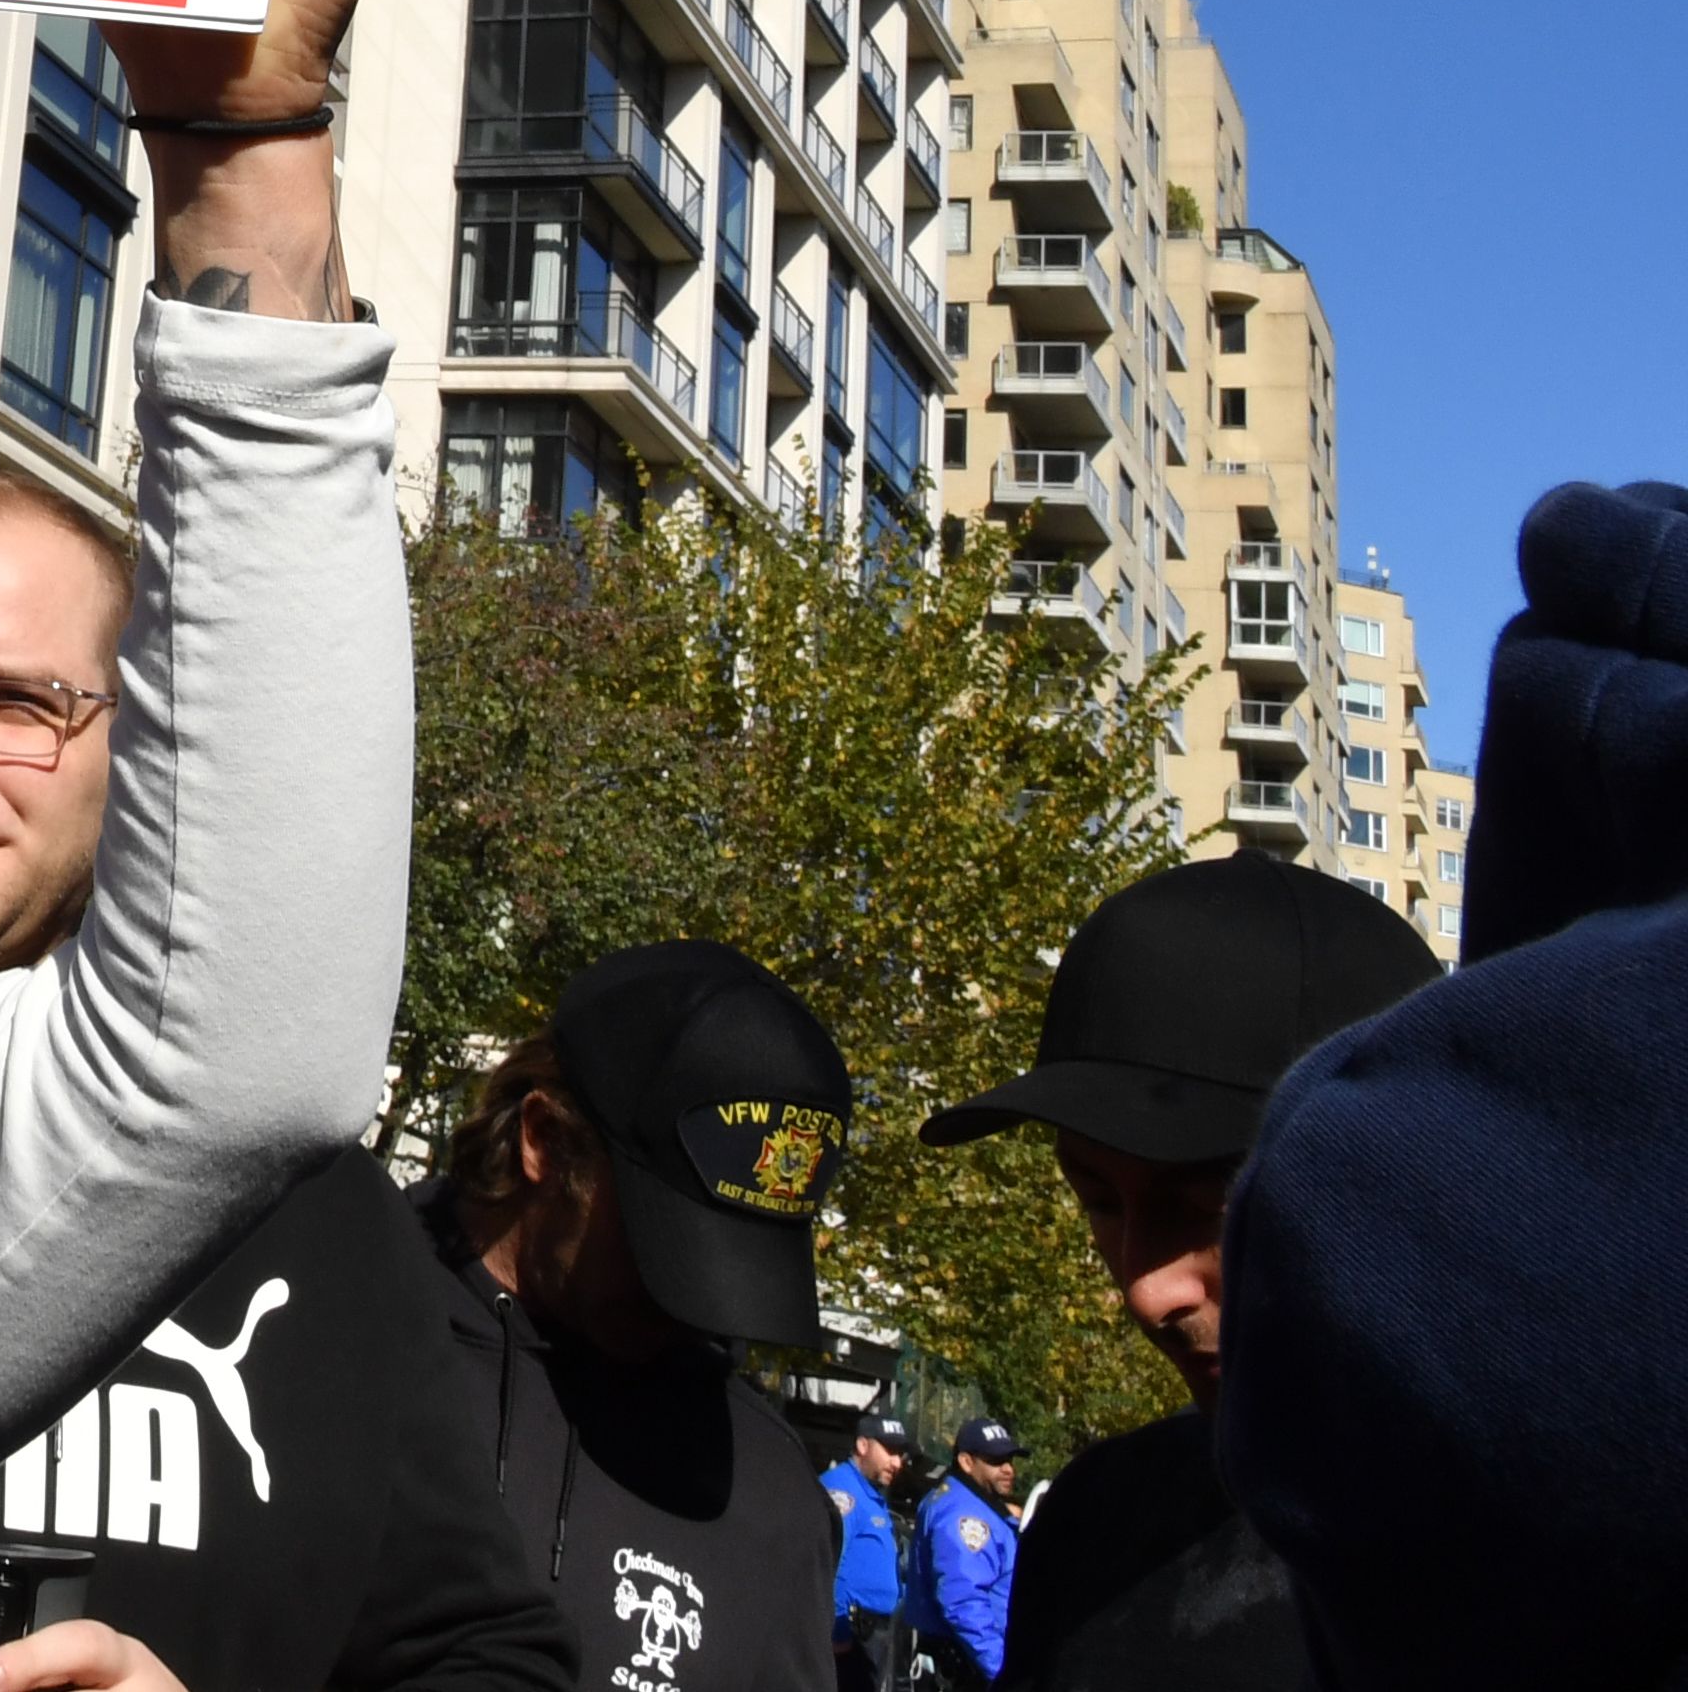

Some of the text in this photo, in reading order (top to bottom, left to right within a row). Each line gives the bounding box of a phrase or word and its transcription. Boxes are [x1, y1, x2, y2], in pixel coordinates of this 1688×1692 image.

[717, 1101, 770, 1126] VFW
[781, 1104, 833, 1133] POST
[716, 1179, 743, 1200] EAST
